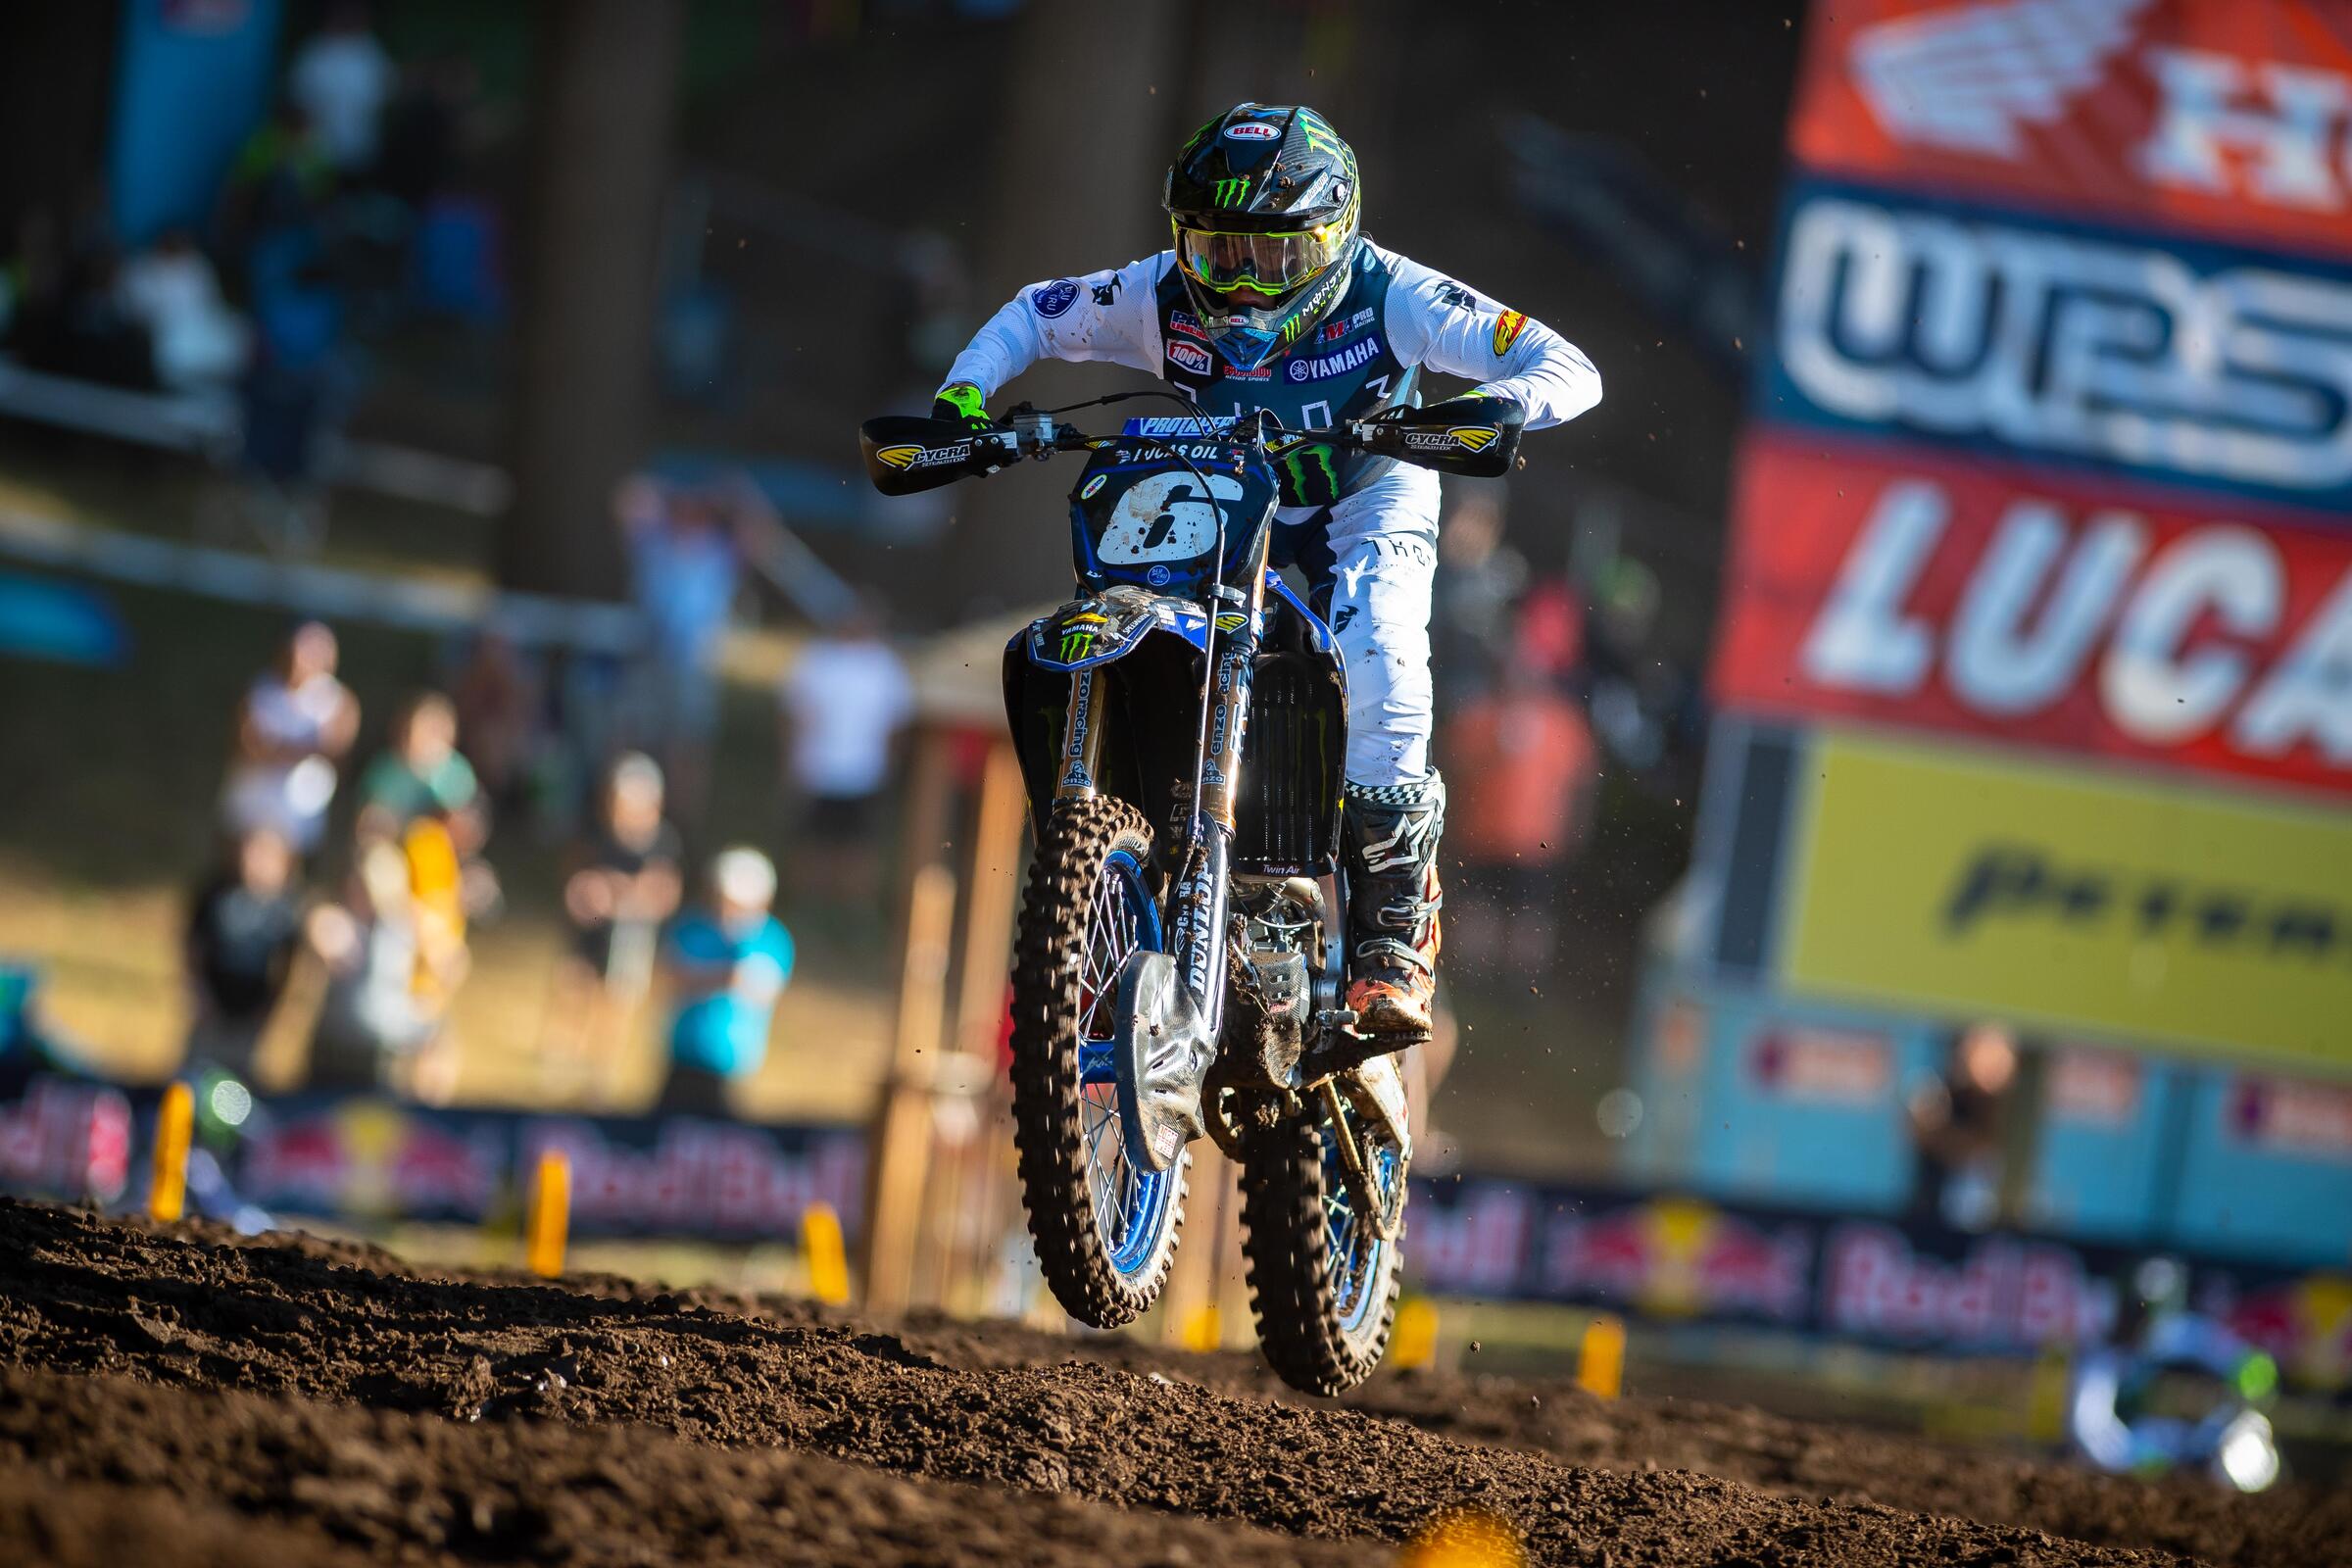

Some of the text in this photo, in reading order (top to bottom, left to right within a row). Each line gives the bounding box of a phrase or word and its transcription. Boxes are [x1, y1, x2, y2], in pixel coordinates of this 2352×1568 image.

[1233, 126, 1271, 138] BELL
[2134, 45, 2352, 216] H
[1352, 307, 1374, 324] PRO
[1354, 316, 1375, 329] RACING
[1171, 345, 1206, 370] 100%
[1308, 336, 1380, 380] YAMAHA
[1404, 433, 1460, 447] CYCRA
[911, 444, 971, 463] CYCRA
[1191, 446, 1218, 460] OIL
[1097, 470, 1245, 565] 6
[1061, 624, 1099, 636] YAMAHA
[1062, 774, 1091, 786] enzo
[1201, 774, 1224, 783] nzo
[1263, 863, 1299, 874] Twin Air
[1189, 860, 1214, 997] DUNLOP
